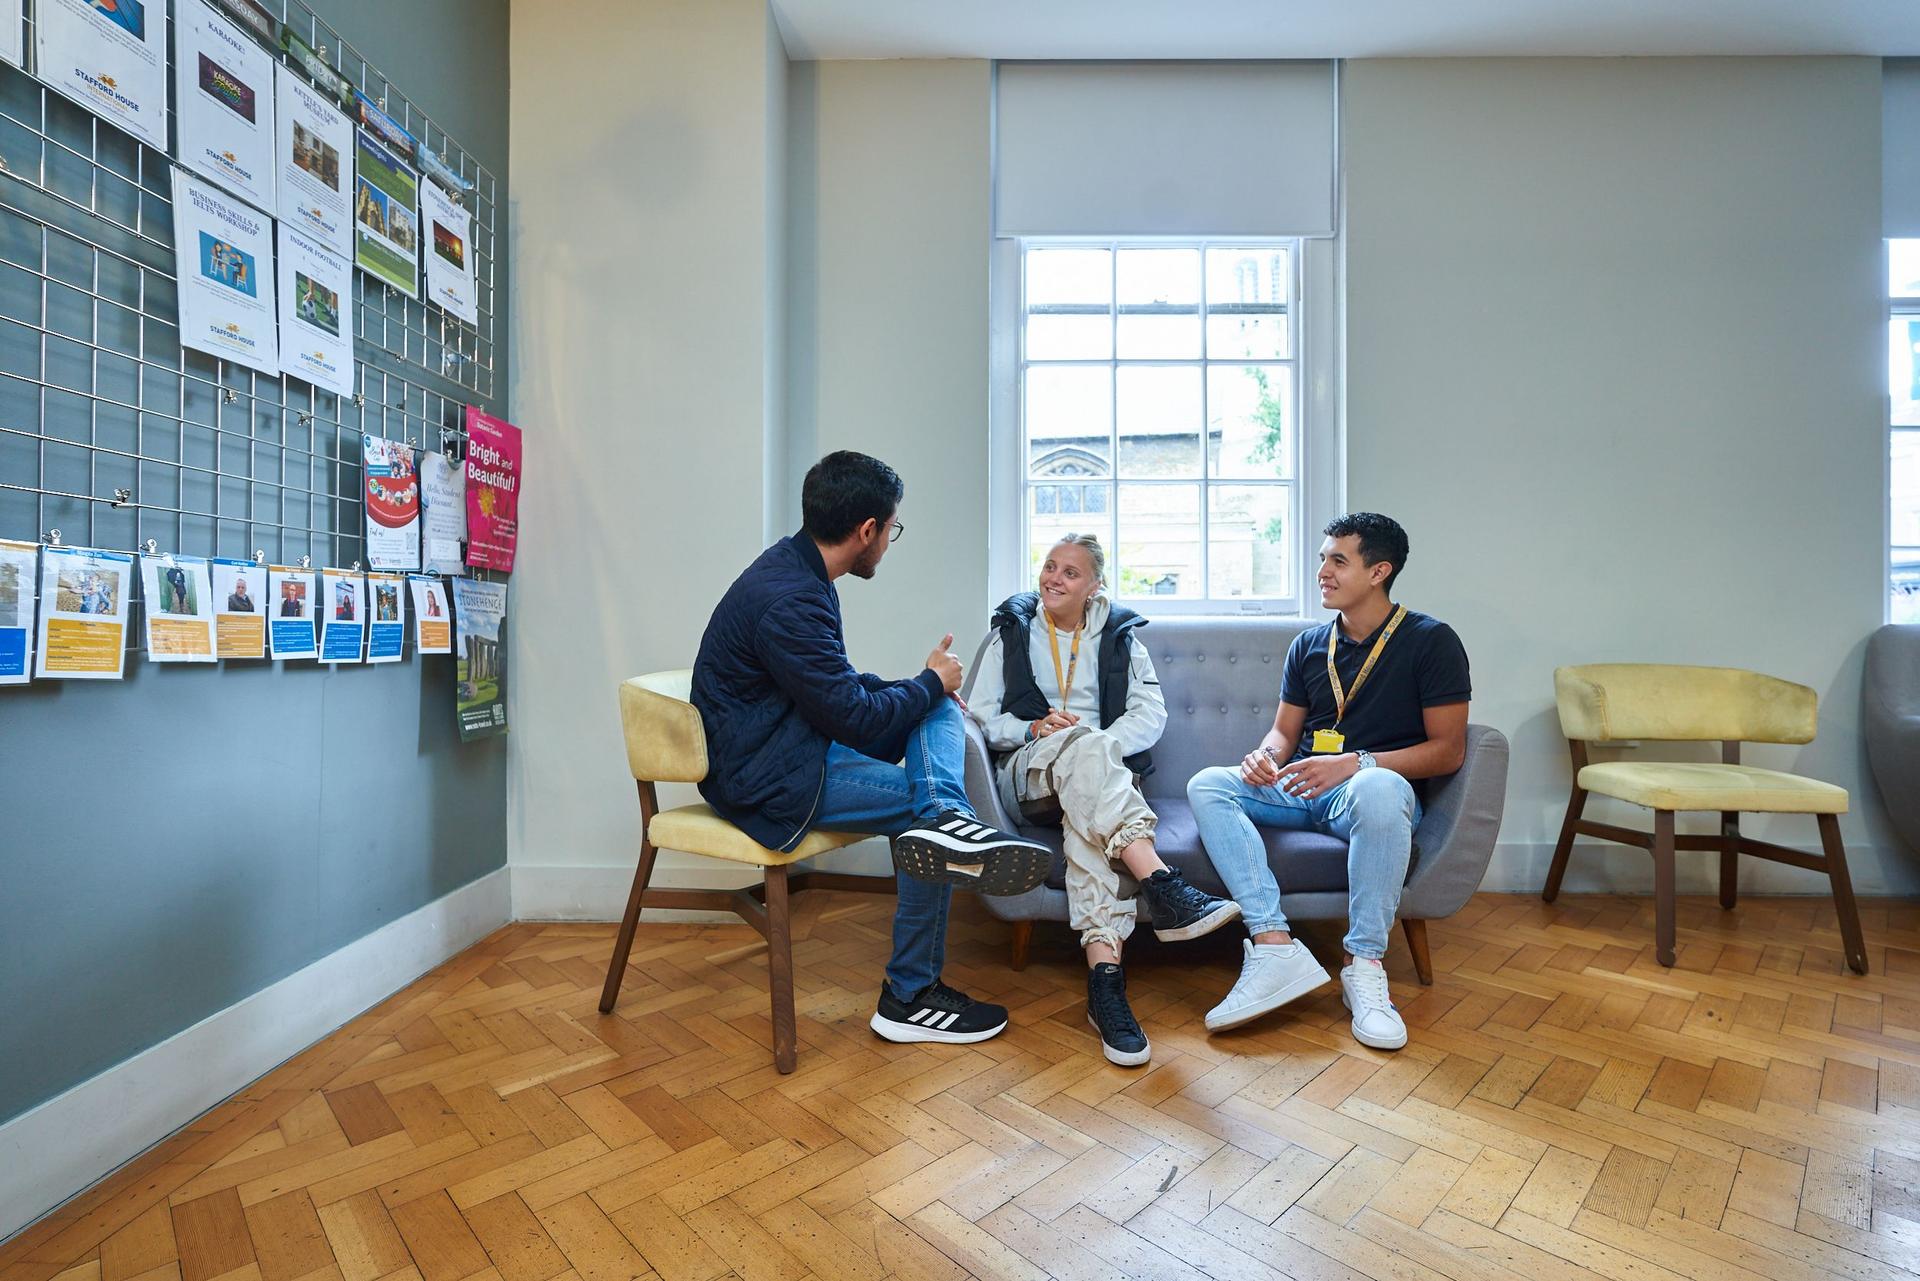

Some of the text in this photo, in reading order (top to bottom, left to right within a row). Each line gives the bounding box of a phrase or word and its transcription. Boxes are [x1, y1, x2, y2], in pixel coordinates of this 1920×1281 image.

[75, 68, 139, 112] STAFFORD HOUSE
[205, 148, 252, 180] STAFFORD HOUSE
[189, 187, 260, 231] BUSINESS SKILLS &
[193, 198, 258, 237] IELTS WORKSHOP
[297, 206, 321, 225] STAFFORD
[290, 234, 342, 271] INDOOR FOOTBALL
[210, 325, 238, 340] STAFFORD
[300, 352, 322, 367] STAFFORD
[469, 440, 513, 470] Bright and
[468, 462, 516, 493] Beautiful!
